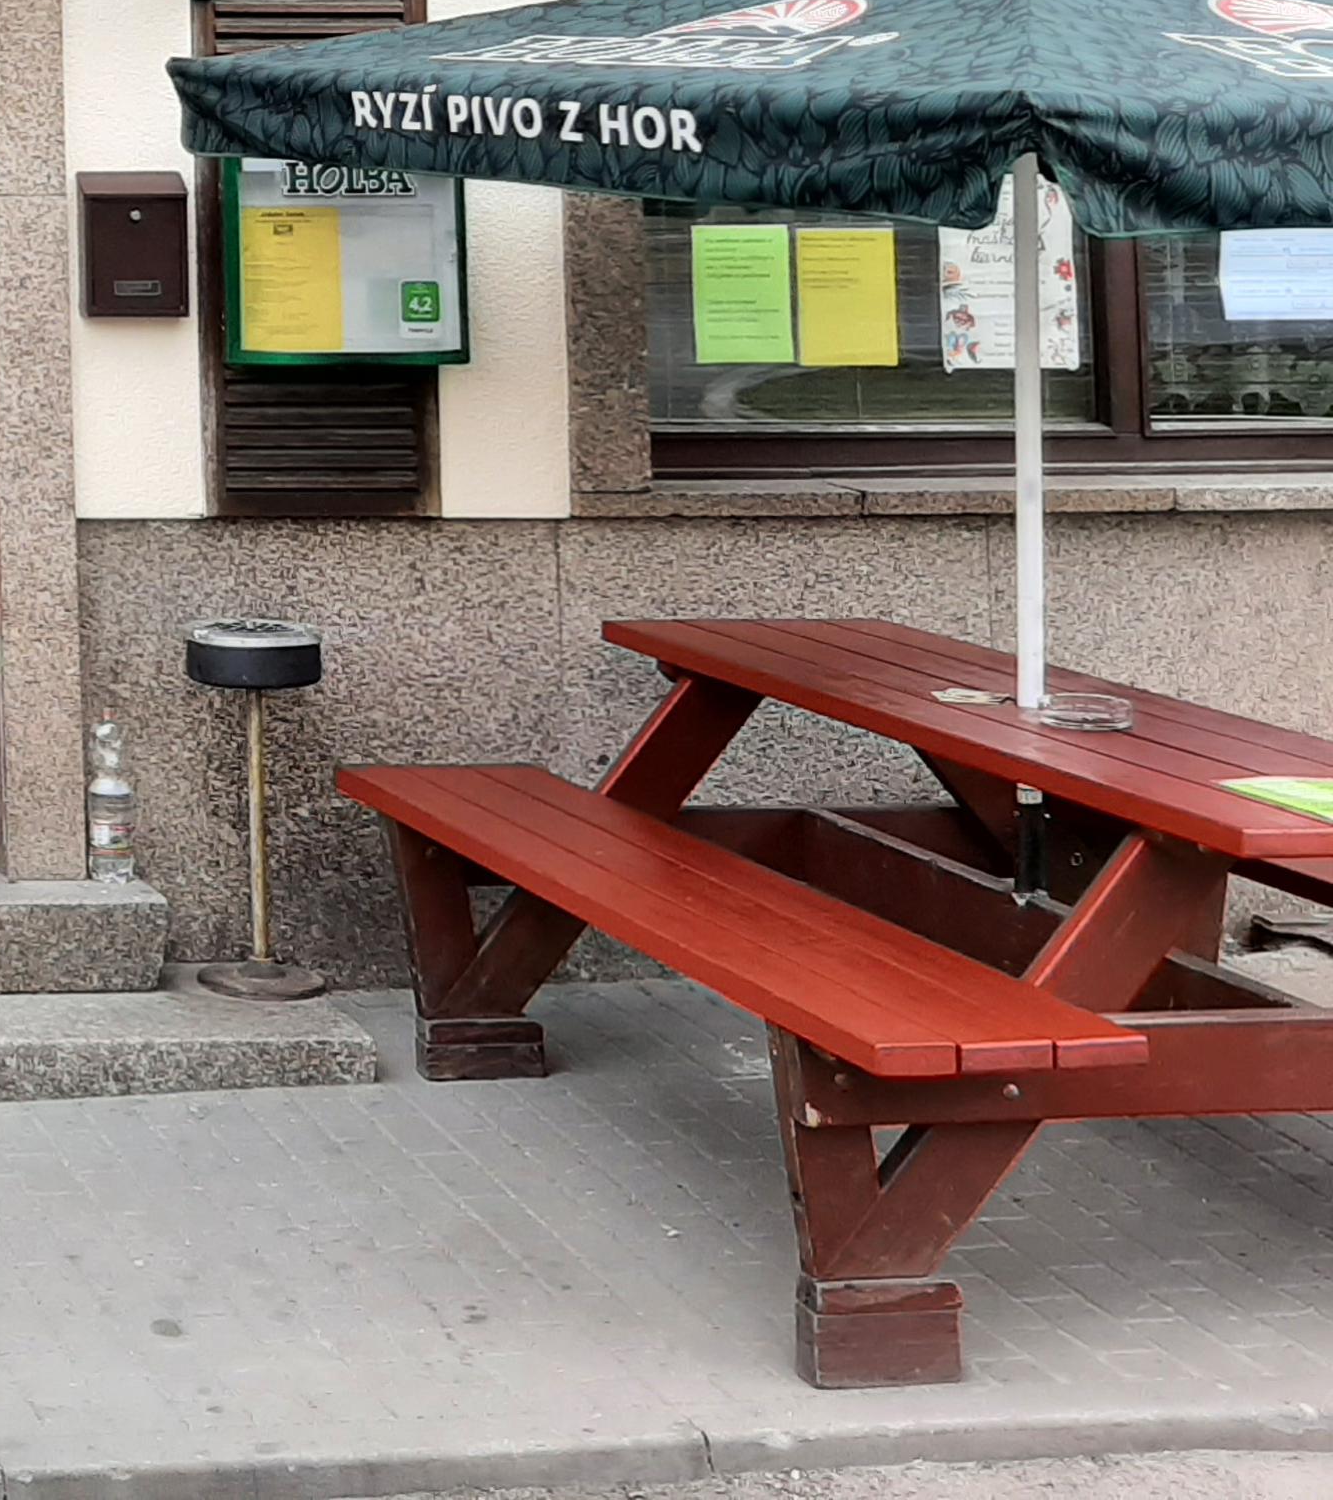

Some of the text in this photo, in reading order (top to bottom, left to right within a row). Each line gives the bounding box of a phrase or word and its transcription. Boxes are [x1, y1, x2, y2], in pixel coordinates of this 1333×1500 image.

[351, 84, 702, 153] RYZÍ PIVO Z HOR
